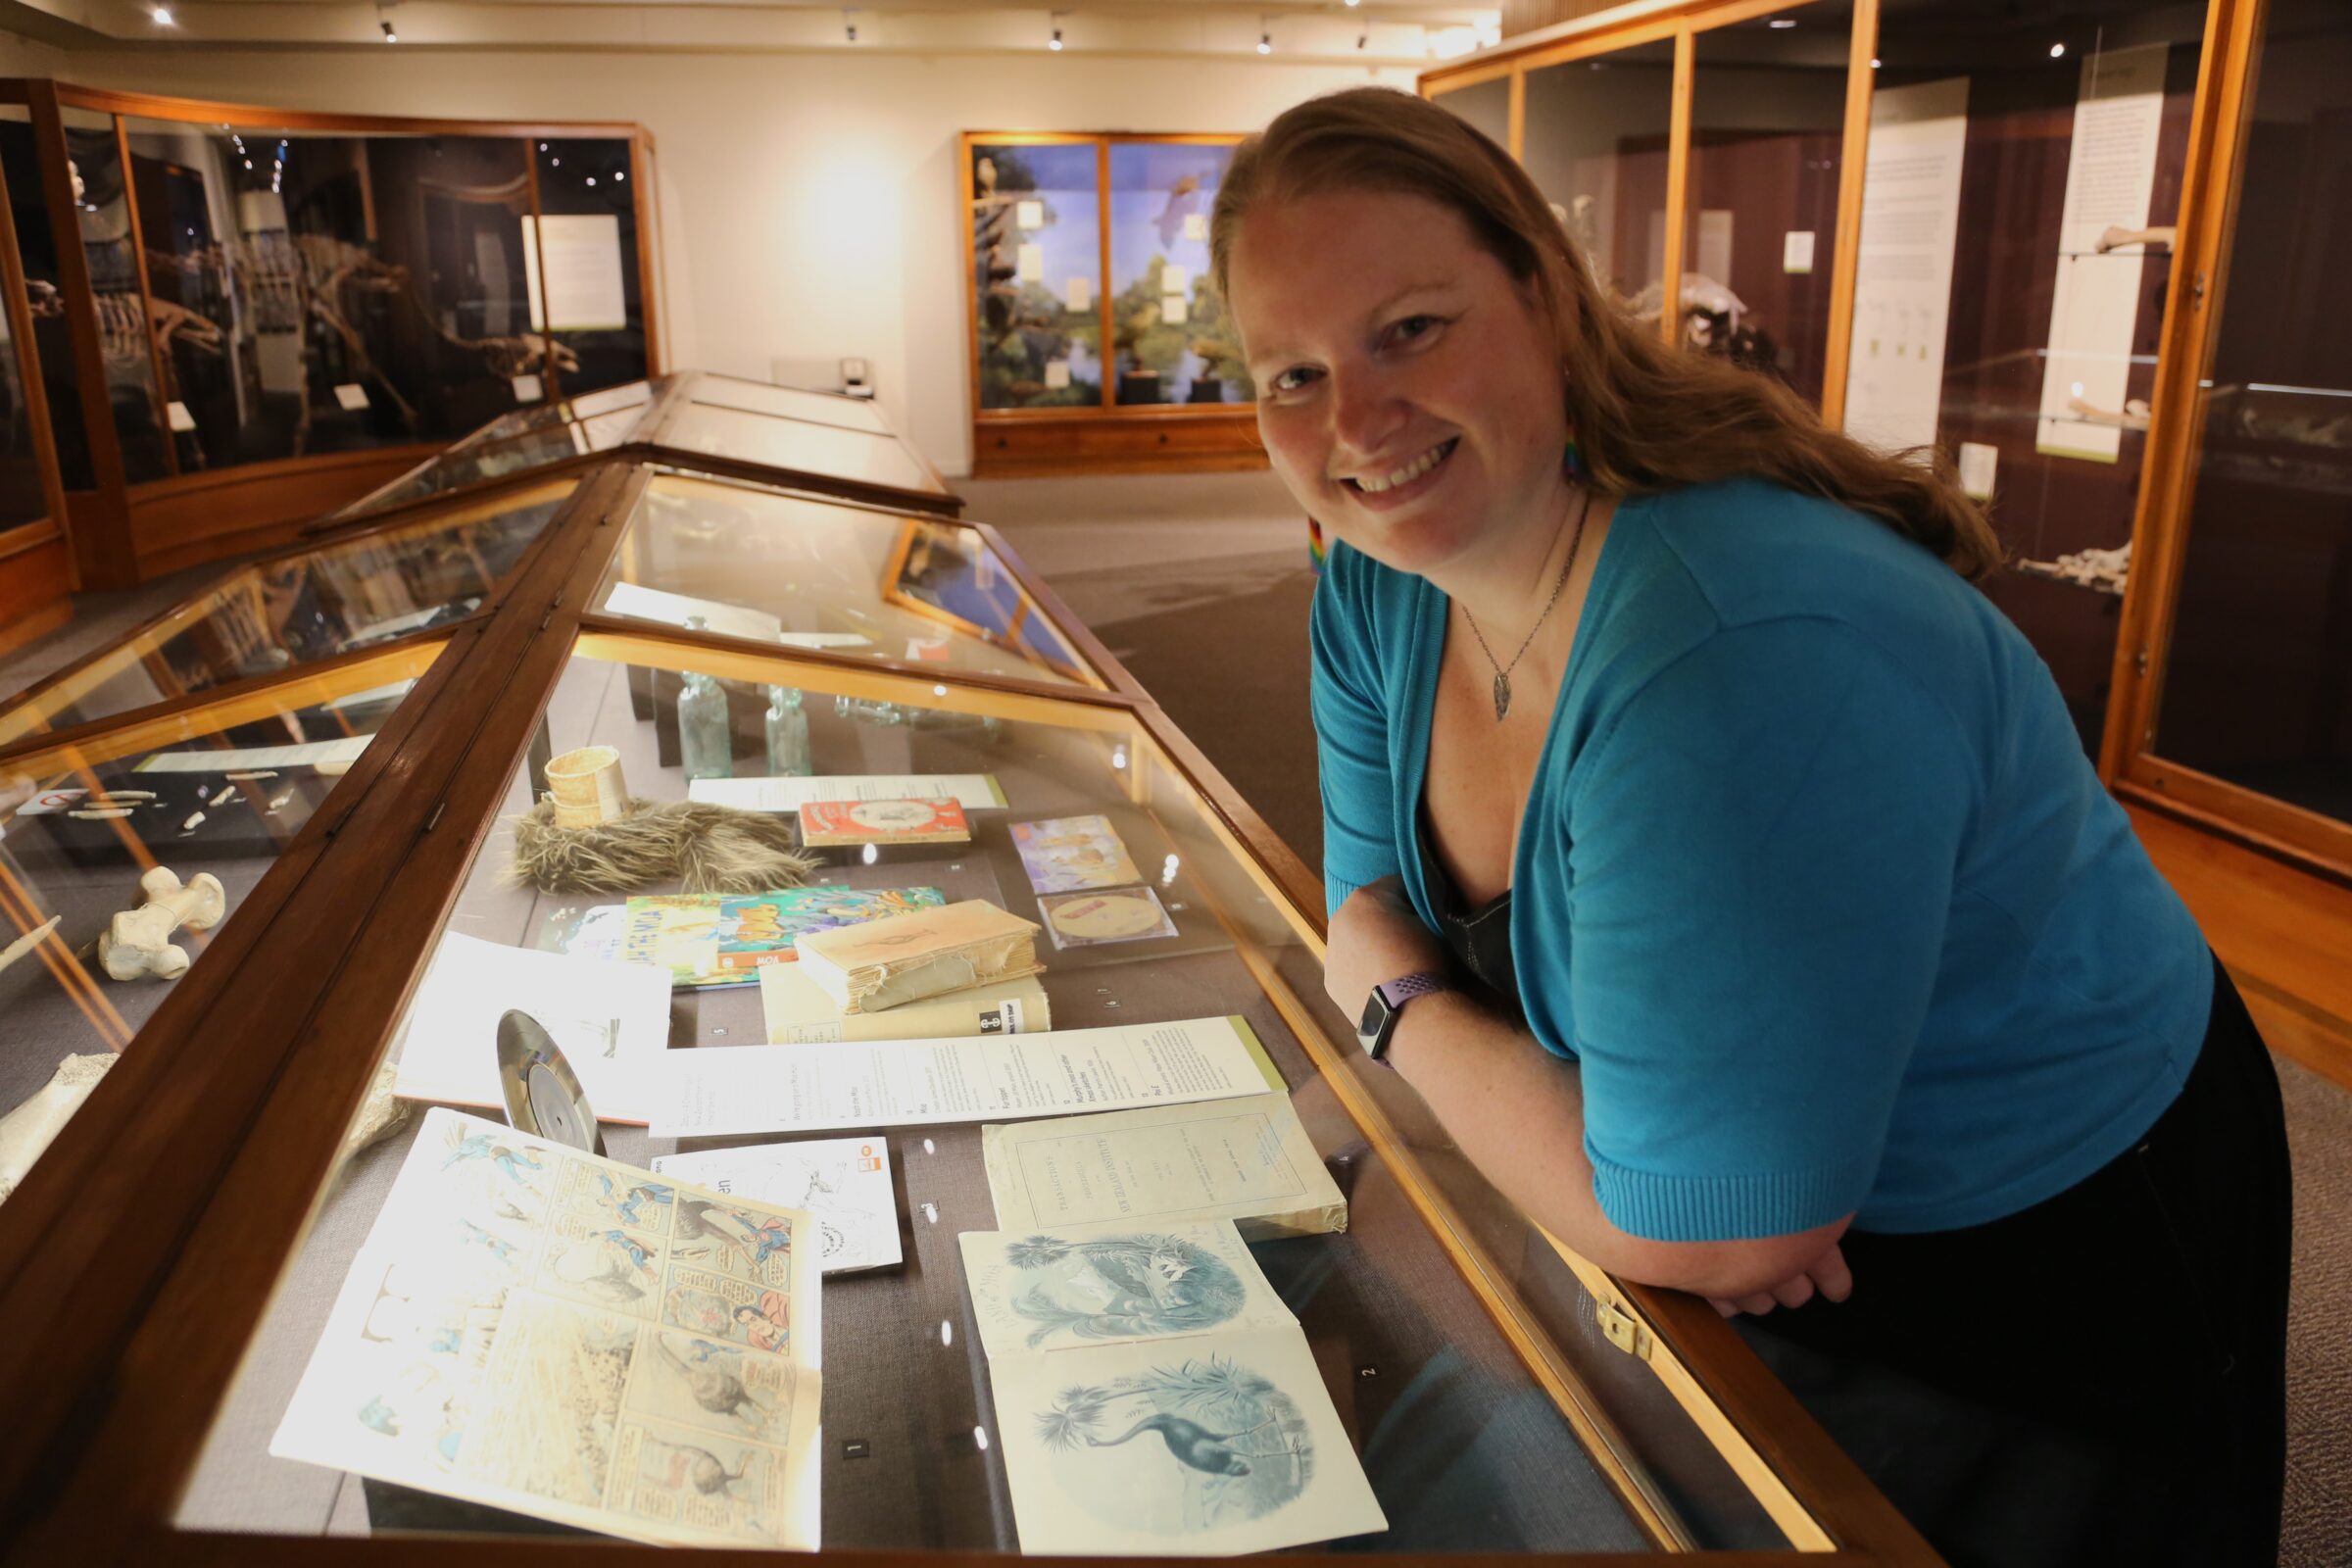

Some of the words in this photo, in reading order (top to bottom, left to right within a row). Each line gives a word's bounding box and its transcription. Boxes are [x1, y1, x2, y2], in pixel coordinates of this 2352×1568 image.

[631, 909, 663, 932] MOA
[626, 934, 658, 950] THE
[1072, 1084, 1083, 1102] Murphy's
[1097, 1139, 1115, 1171] INSTITUTE
[1045, 1154, 1068, 1211] TRANSACTIONS
[1109, 1171, 1126, 1198] ZEALAND
[1118, 1200, 1131, 1213] NEW
[1361, 1368, 1376, 1377] 2
